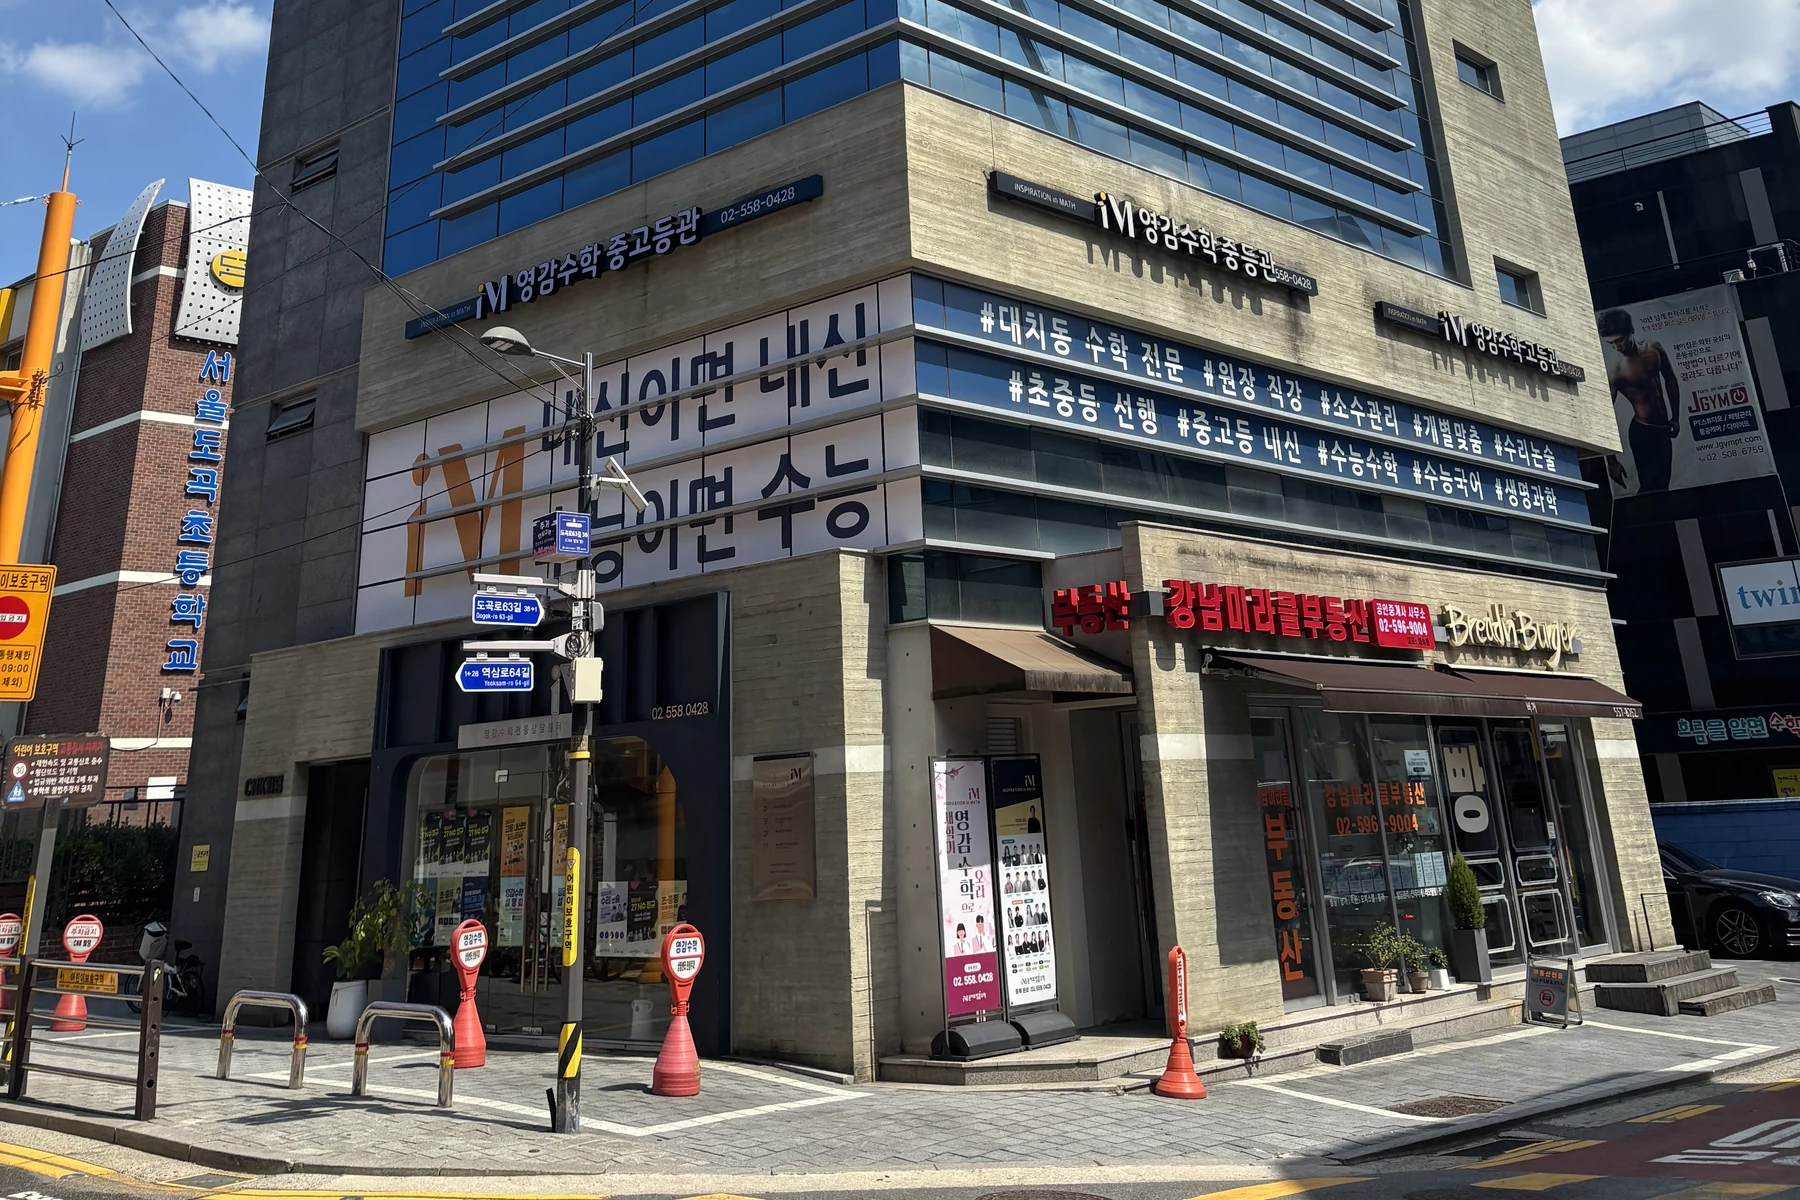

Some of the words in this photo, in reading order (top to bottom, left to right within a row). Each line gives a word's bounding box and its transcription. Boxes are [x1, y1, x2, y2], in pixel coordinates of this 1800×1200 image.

[720, 187, 796, 224] 02-558-0428
[1014, 183, 1051, 203] INSPIRATION
[1059, 197, 1076, 210] MATH
[516, 242, 601, 303] 영감수학
[607, 206, 700, 271] 중고등관
[1275, 268, 1312, 290] 558-0428
[456, 305, 471, 316] MATH
[1708, 349, 1741, 364] 다르기에
[1680, 368, 1704, 381] 결과도
[542, 341, 736, 467] 내신이면
[759, 302, 870, 408] 내신
[980, 302, 1072, 357] #대치동
[1085, 326, 1129, 371] 수학
[1141, 341, 1184, 384] 전문
[1203, 359, 1256, 401] #원장
[1266, 373, 1303, 412] 직강
[1320, 389, 1399, 436] #소수관리
[1413, 413, 1482, 455] #개별맞춤
[1494, 433, 1556, 473] #수리논술
[1687, 390, 1731, 413] JGYM
[1726, 420, 1750, 430] 다이어트
[1008, 370, 1100, 423] #초중등
[1113, 392, 1157, 435] 선행
[1178, 408, 1253, 455] #중고등
[1263, 425, 1302, 465] 내신
[1318, 439, 1398, 484] #수능수학
[1412, 460, 1484, 501] #수능국어
[1495, 477, 1558, 516] #생명과학
[1741, 445, 1764, 456] 6759
[162, 350, 233, 673] 서울도곡초등학교
[540, 467, 736, 583] 능이면
[758, 444, 878, 551] 수능
[476, 601, 522, 613] 도곡로63길
[1053, 580, 1131, 637] 부동산
[1162, 579, 1370, 643] 강남미라클부동산
[1376, 602, 1407, 618] 공인중개사
[1408, 606, 1426, 619] 사무소
[1378, 617, 1428, 636] 02-596-9004
[1514, 609, 1579, 670] Burger
[1, 664, 29, 673] 09:00
[481, 667, 530, 678] 역삼로64길
[484, 679, 514, 687] Yeoksam-ro
[515, 679, 531, 687] 64-gil
[1677, 718, 1729, 745] 흐름을
[1729, 715, 1770, 740] 알면
[14, 744, 32, 757] 어린이
[34, 743, 59, 755] 보호구역
[15, 766, 25, 774] 30
[67, 757, 90, 766] 교통신호
[81, 784, 93, 793] 금지
[1336, 814, 1419, 835] 02-596-9004
[955, 810, 975, 900] 영감수학
[975, 870, 985, 899] 오라
[1265, 813, 1304, 982] 부동산
[564, 873, 574, 951] 어린이보호구역
[961, 903, 975, 914] 으로
[0, 925, 20, 934] 차금지
[71, 928, 97, 936] 주차금지
[464, 932, 482, 946] 영감수학
[675, 940, 697, 954] 영감수학
[978, 972, 994, 982] 0428
